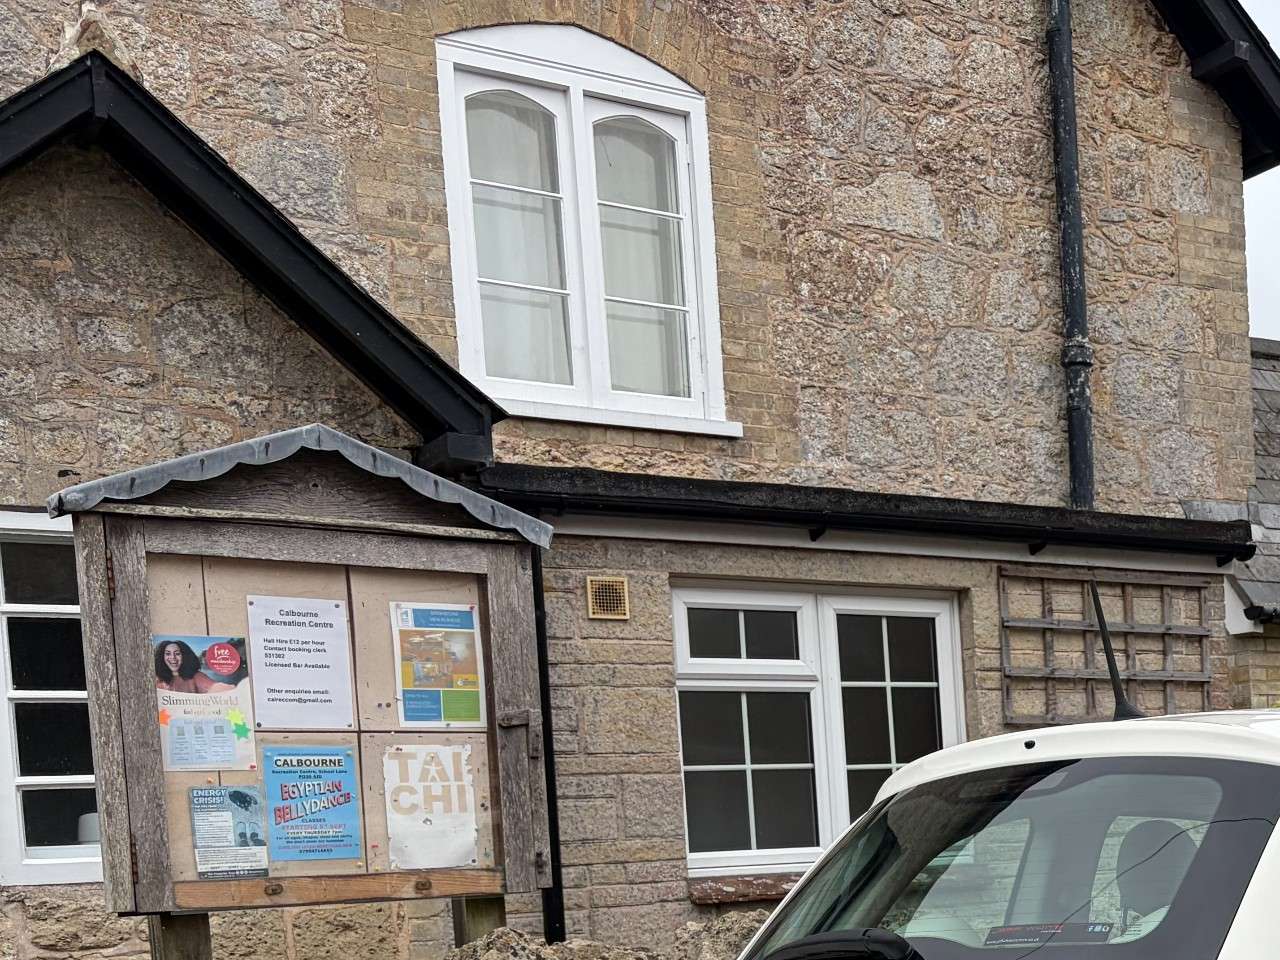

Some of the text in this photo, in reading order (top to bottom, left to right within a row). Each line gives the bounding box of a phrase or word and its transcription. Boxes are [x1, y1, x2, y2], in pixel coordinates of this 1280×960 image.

[265, 618, 306, 627] Recreation
[279, 610, 319, 618] Calbourne
[274, 758, 344, 767] CALBOURNE
[388, 752, 464, 782] TAI
[281, 780, 342, 801] EGYPTIAN
[390, 784, 468, 816] CHI
[274, 792, 351, 825] BELLYDANCE
